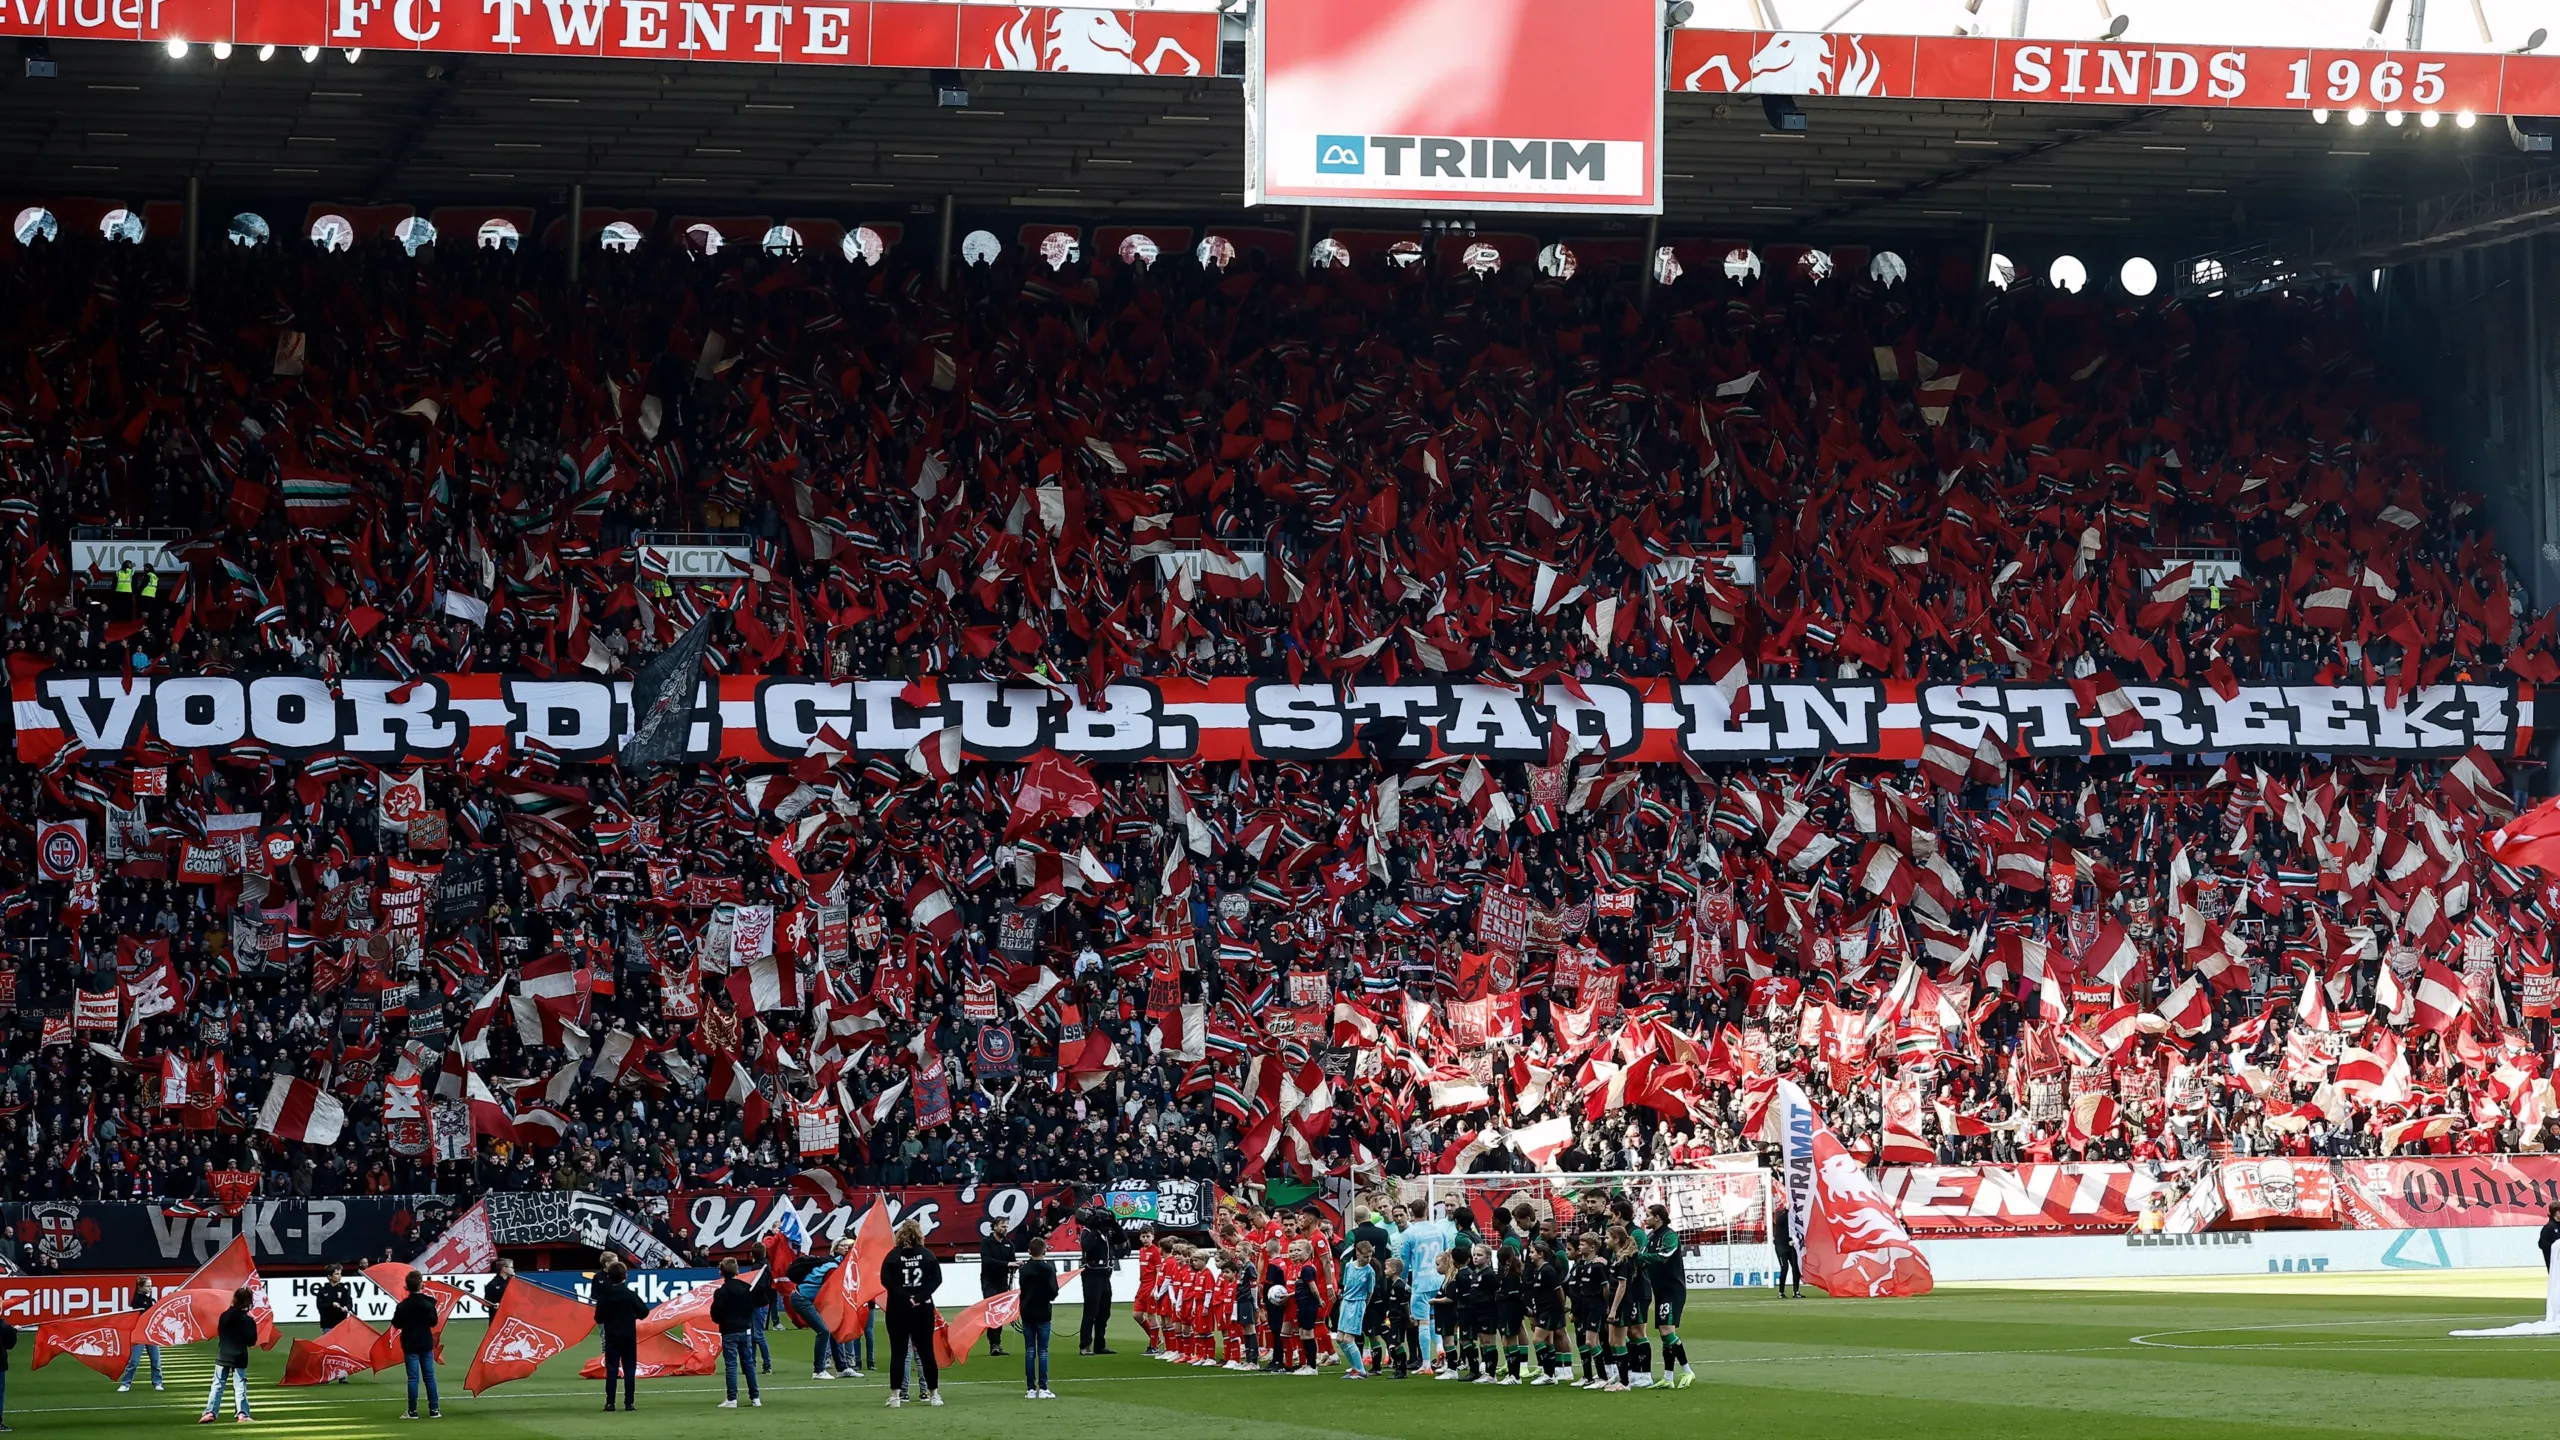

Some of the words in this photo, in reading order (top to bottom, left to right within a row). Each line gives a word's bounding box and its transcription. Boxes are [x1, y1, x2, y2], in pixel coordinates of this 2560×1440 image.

[332, 0, 441, 42] FC
[482, 0, 851, 55] TWENTE
[2013, 45, 2249, 102] SINDS
[2286, 59, 2446, 104] 1965
[1371, 136, 1605, 181] TRIMM
[46, 677, 458, 753] VOOR
[1255, 684, 1633, 751] STAD
[1680, 685, 1876, 750] EN
[1923, 684, 2509, 751] STREEK!
[187, 846, 221, 861] HARD
[184, 859, 223, 874] GOAN!
[440, 876, 484, 899] TWENTE
[380, 891, 421, 906] SINCE
[1487, 889, 1523, 907] AGAINST
[1000, 915, 1037, 927] BYS
[999, 928, 1034, 939] FROM
[1481, 918, 1522, 940] ERN
[999, 938, 1034, 951] HELL!
[1290, 975, 1327, 991] RED
[383, 988, 402, 1000] ULT
[80, 1004, 117, 1014] TWENTE
[383, 998, 403, 1010] RAS
[964, 1008, 995, 1016] NSCHEDE
[78, 1017, 118, 1028] ENSCHEDE
[1160, 1180, 1199, 1195] THE
[485, 1191, 568, 1210] SEKTION
[46, 1220, 54, 1228] V
[62, 1219, 68, 1227] A
[488, 1205, 570, 1231] STADION
[1158, 1213, 1198, 1226] ELITE
[49, 1234, 56, 1243] K
[63, 1236, 69, 1244] P
[491, 1222, 572, 1244] VERBOD
[902, 1268, 923, 1287] 12
[1687, 1273, 1716, 1284] stro
[1659, 1302, 1670, 1315] 23
